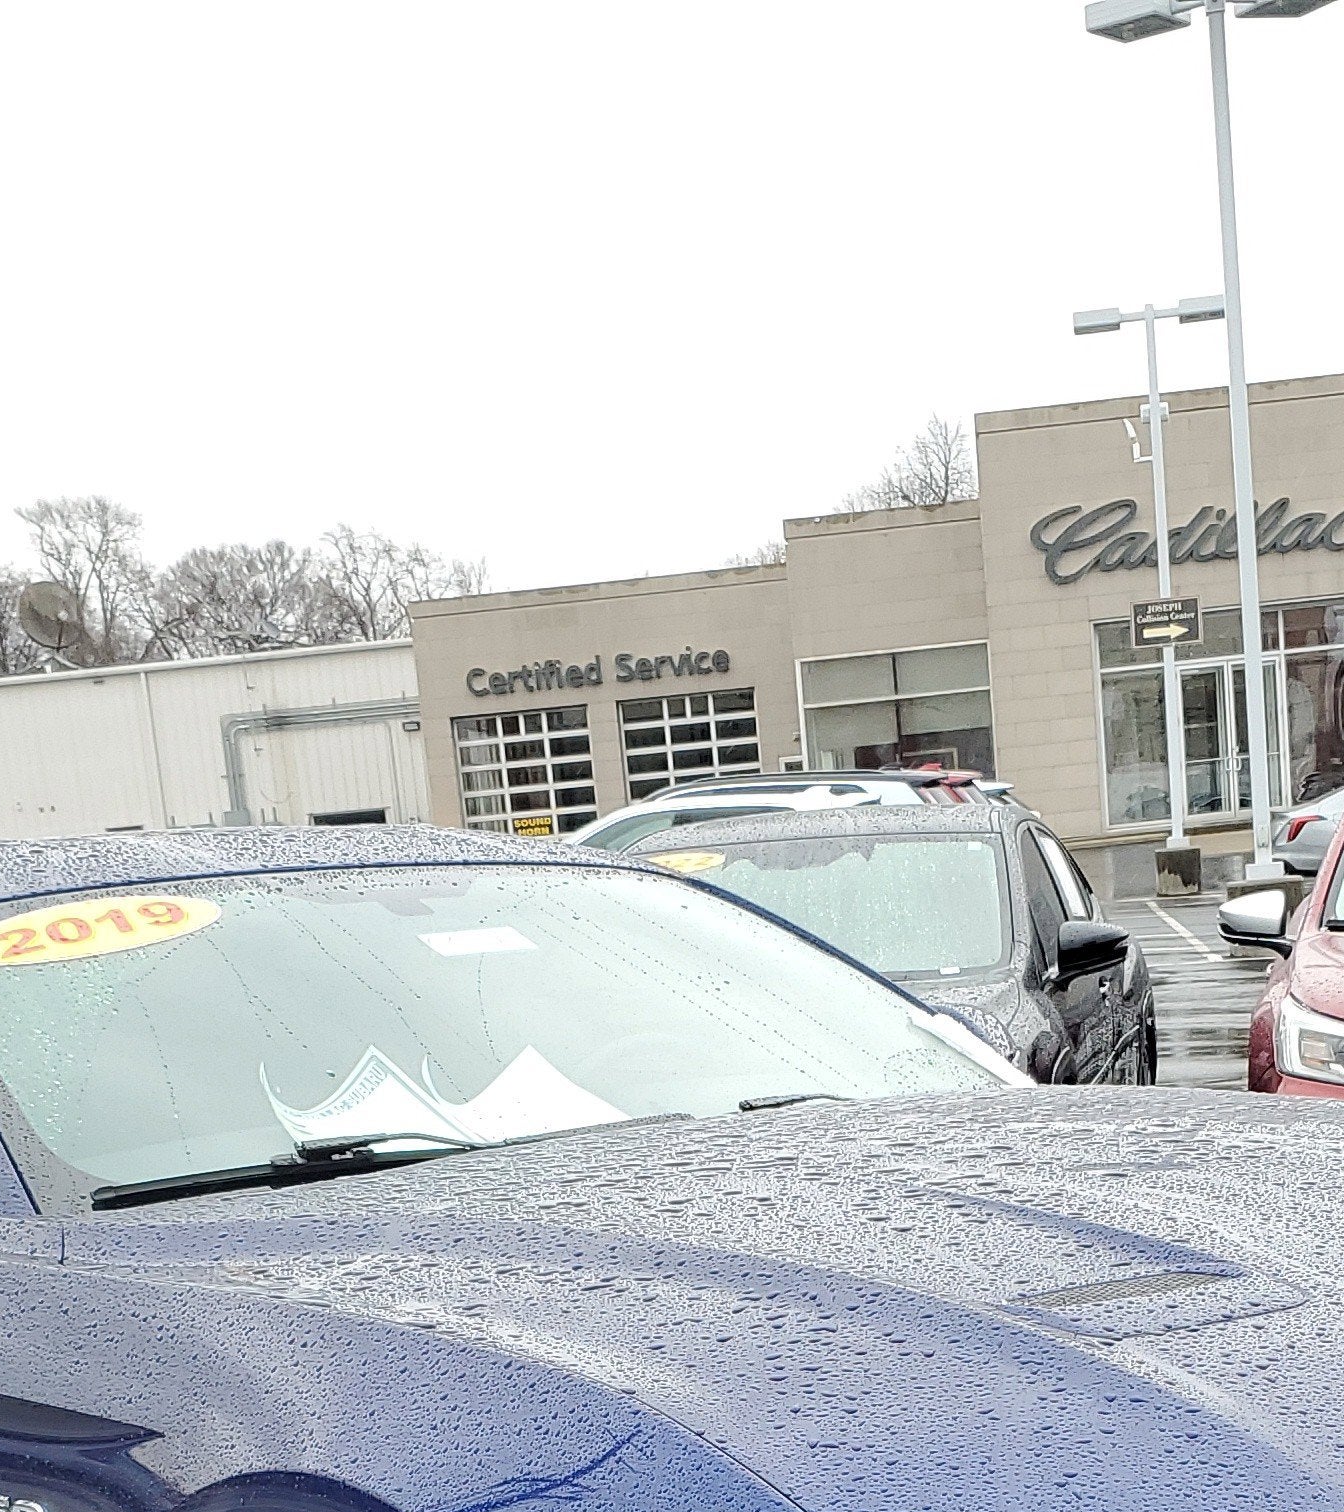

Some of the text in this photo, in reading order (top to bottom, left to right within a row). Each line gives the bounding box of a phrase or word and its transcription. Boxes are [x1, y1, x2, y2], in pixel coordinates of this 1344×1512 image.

[1146, 602, 1182, 614] JOSEPH
[466, 646, 731, 697] Certified Service
[514, 817, 552, 828] SOUND
[517, 827, 550, 836] HORN
